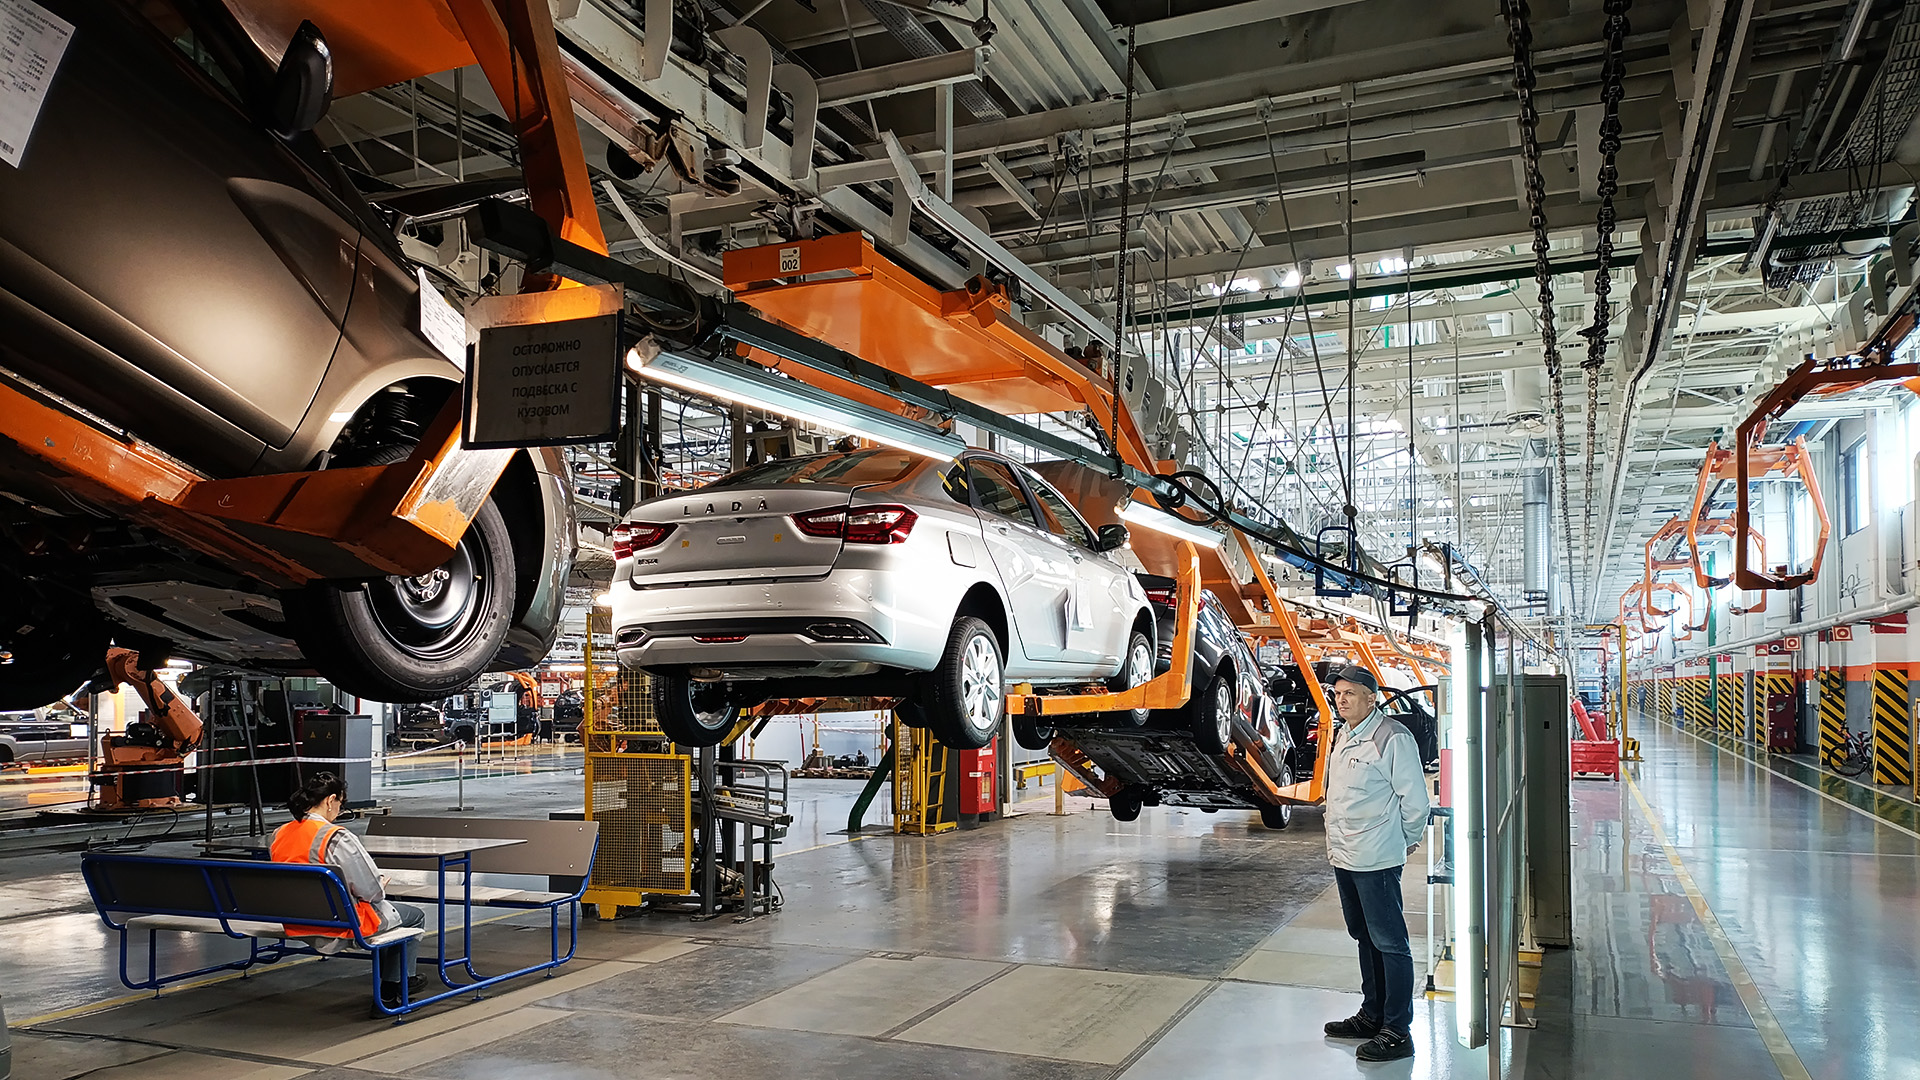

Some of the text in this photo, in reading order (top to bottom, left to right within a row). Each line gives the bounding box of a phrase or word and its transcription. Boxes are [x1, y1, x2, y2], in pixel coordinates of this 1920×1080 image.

[782, 259, 798, 271] 002
[512, 339, 581, 357] ОСТОРОЖНО
[512, 361, 580, 378] ОПУСКАЕТСЯ
[512, 382, 578, 399] ПОДВЕСКА С
[517, 404, 570, 418] КУЗОВОМ
[683, 499, 768, 516] LADA
